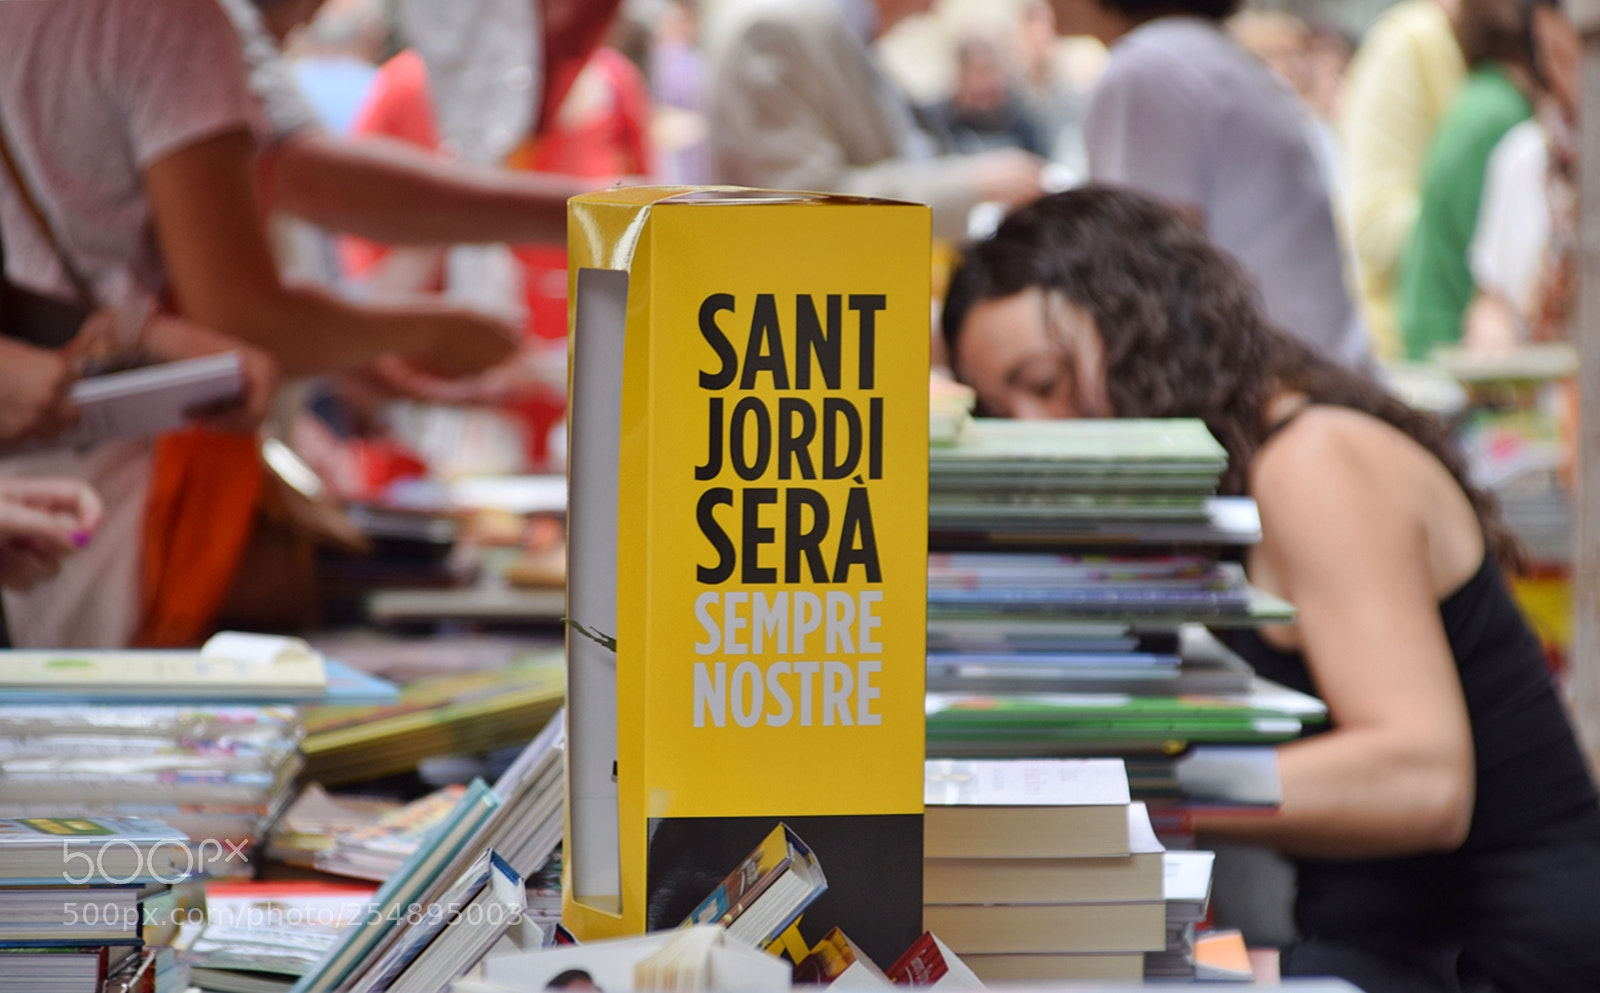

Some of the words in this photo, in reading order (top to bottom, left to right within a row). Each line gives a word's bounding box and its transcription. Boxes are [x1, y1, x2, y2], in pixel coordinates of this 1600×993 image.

[698, 293, 887, 391] SANT
[694, 396, 884, 481] JORDI
[696, 474, 883, 585] SERÀ
[694, 590, 883, 655] SEMPRE
[693, 661, 882, 728] NOSTRE
